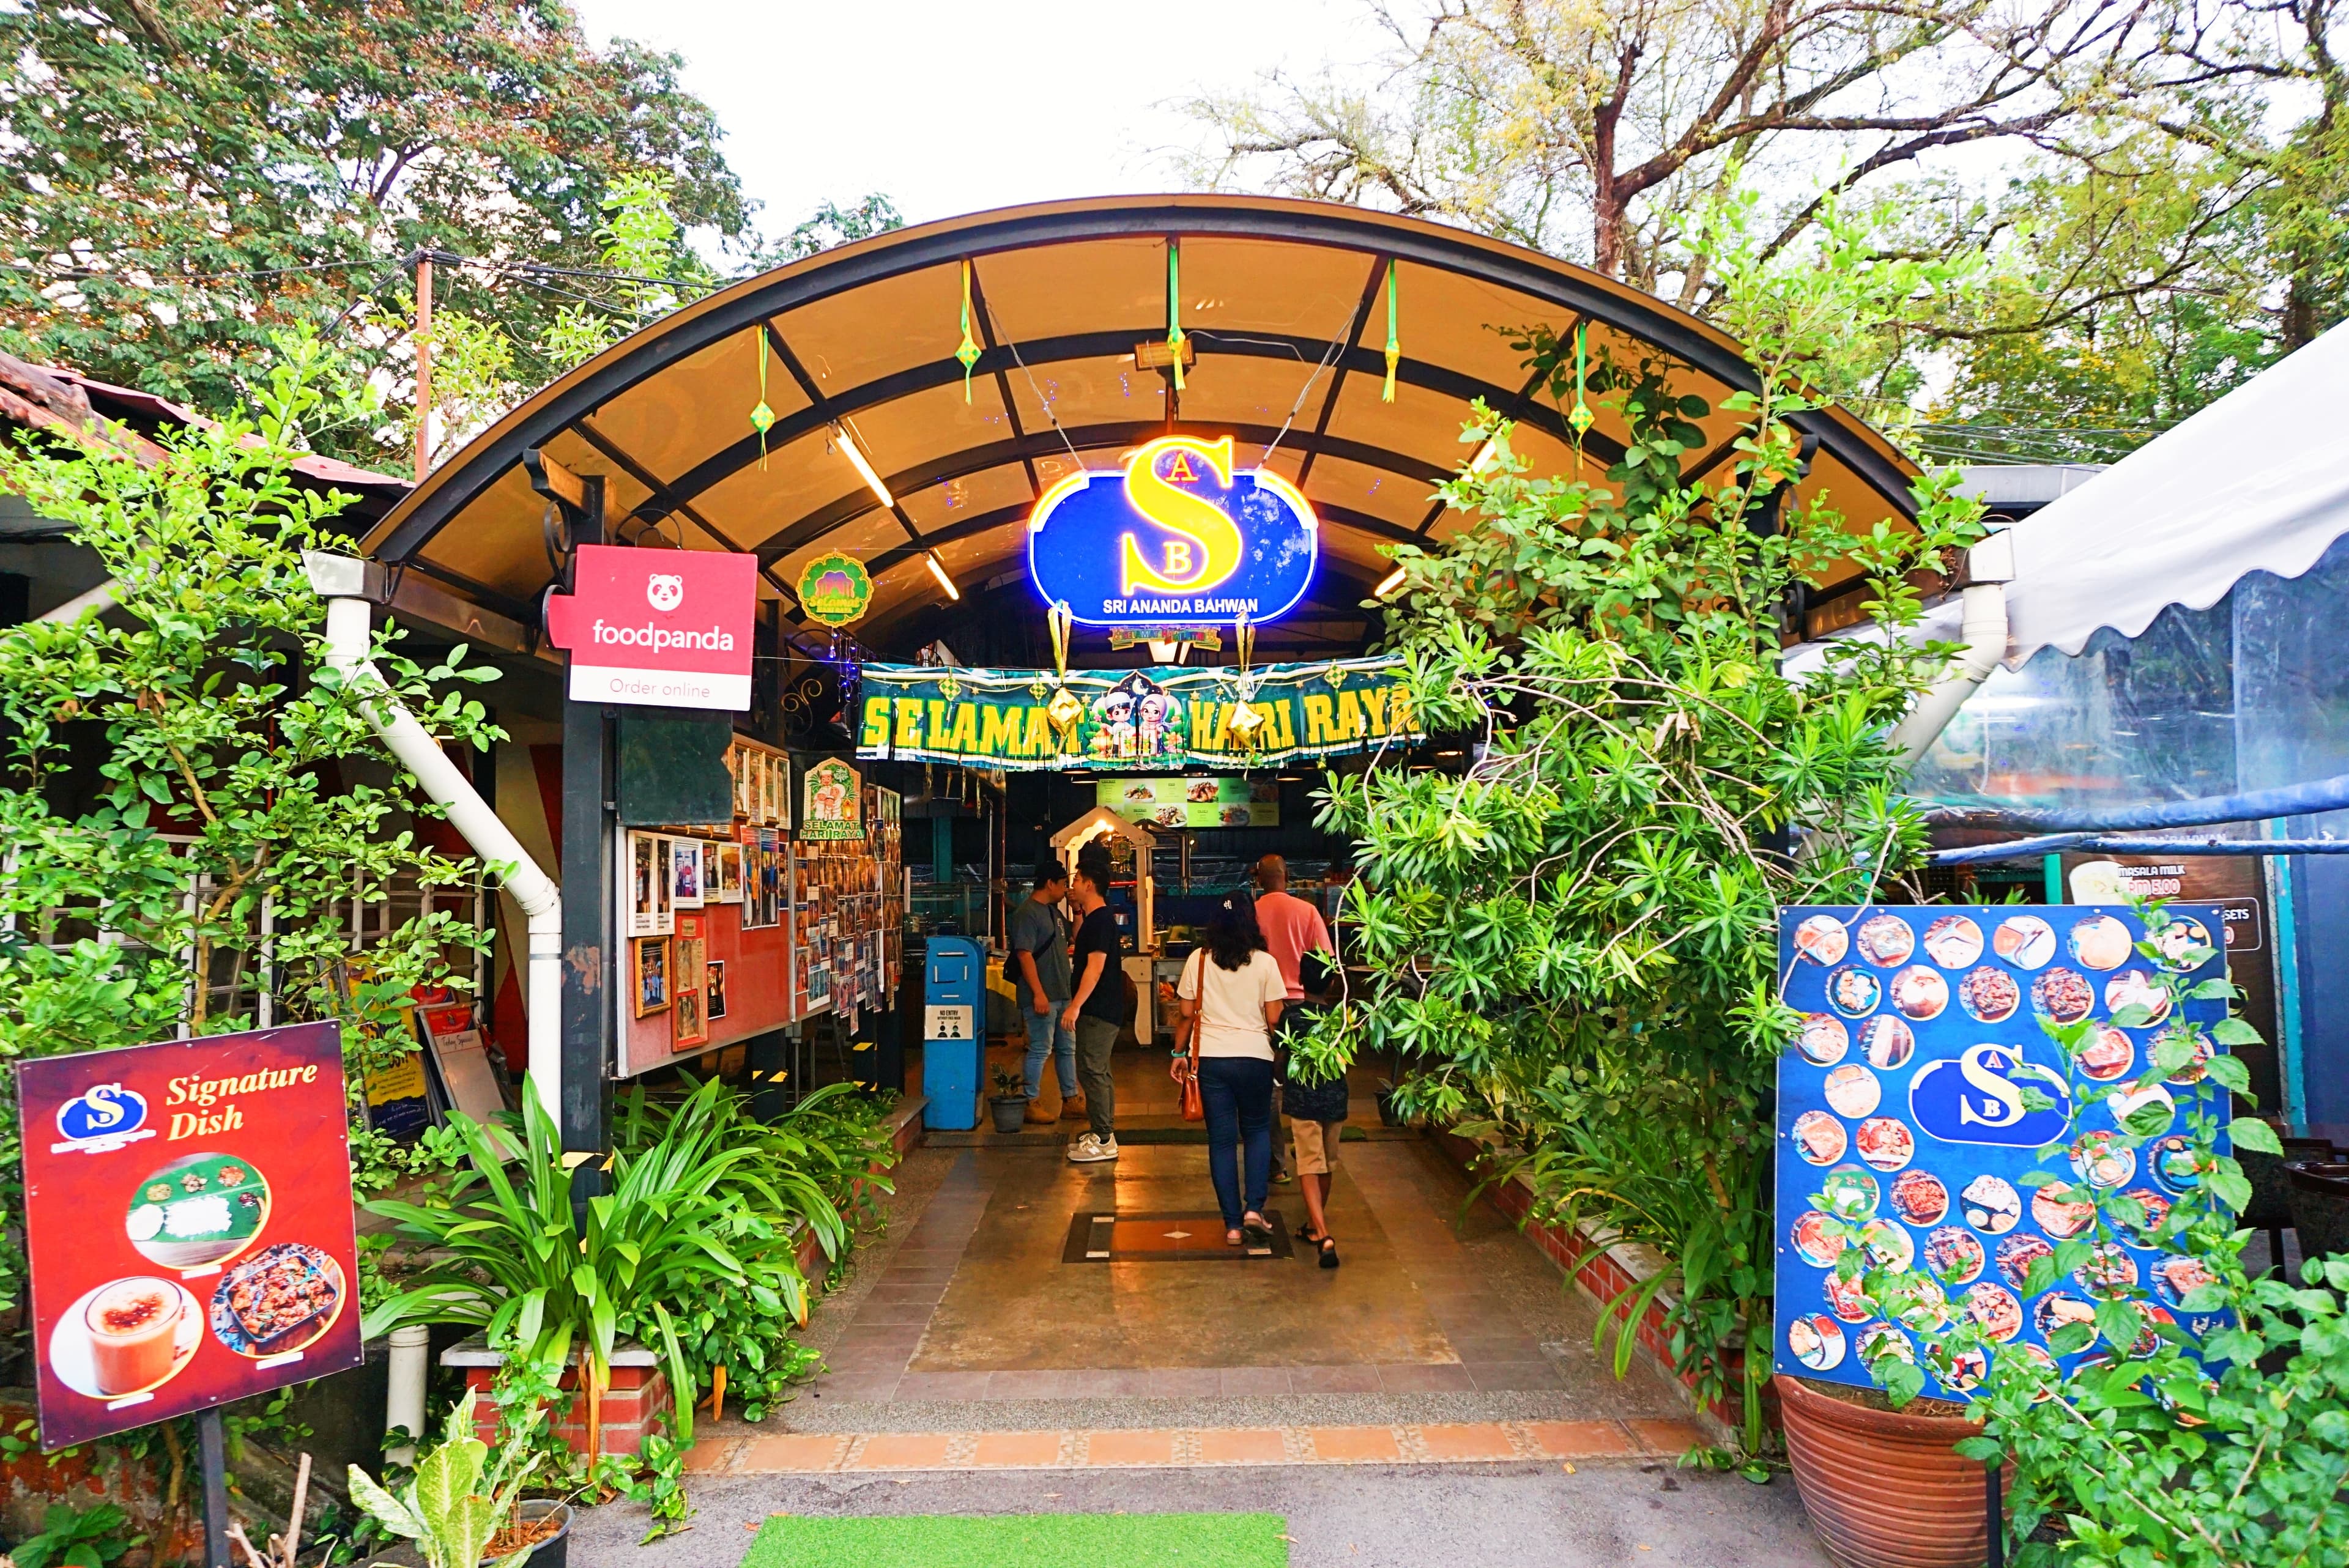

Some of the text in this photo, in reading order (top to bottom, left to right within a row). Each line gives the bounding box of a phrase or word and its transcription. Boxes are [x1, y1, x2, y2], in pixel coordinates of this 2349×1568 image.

[1166, 453, 1198, 481] A
[1121, 435, 1242, 595] S
[1163, 541, 1192, 574] B
[1103, 598, 1258, 614] SRI ANANDA BAHWAN
[593, 619, 733, 653] foodpanda
[610, 678, 710, 698] Order online
[1304, 685, 1420, 744] RAYA
[801, 830, 862, 838] HARI RAYA
[804, 821, 859, 830] SELAMAT
[2118, 865, 2186, 877] MASALA MILK
[1984, 1051, 2004, 1068] A
[166, 1063, 318, 1107] Signature
[1982, 1099, 2000, 1117] B
[168, 1106, 243, 1142] Dish
